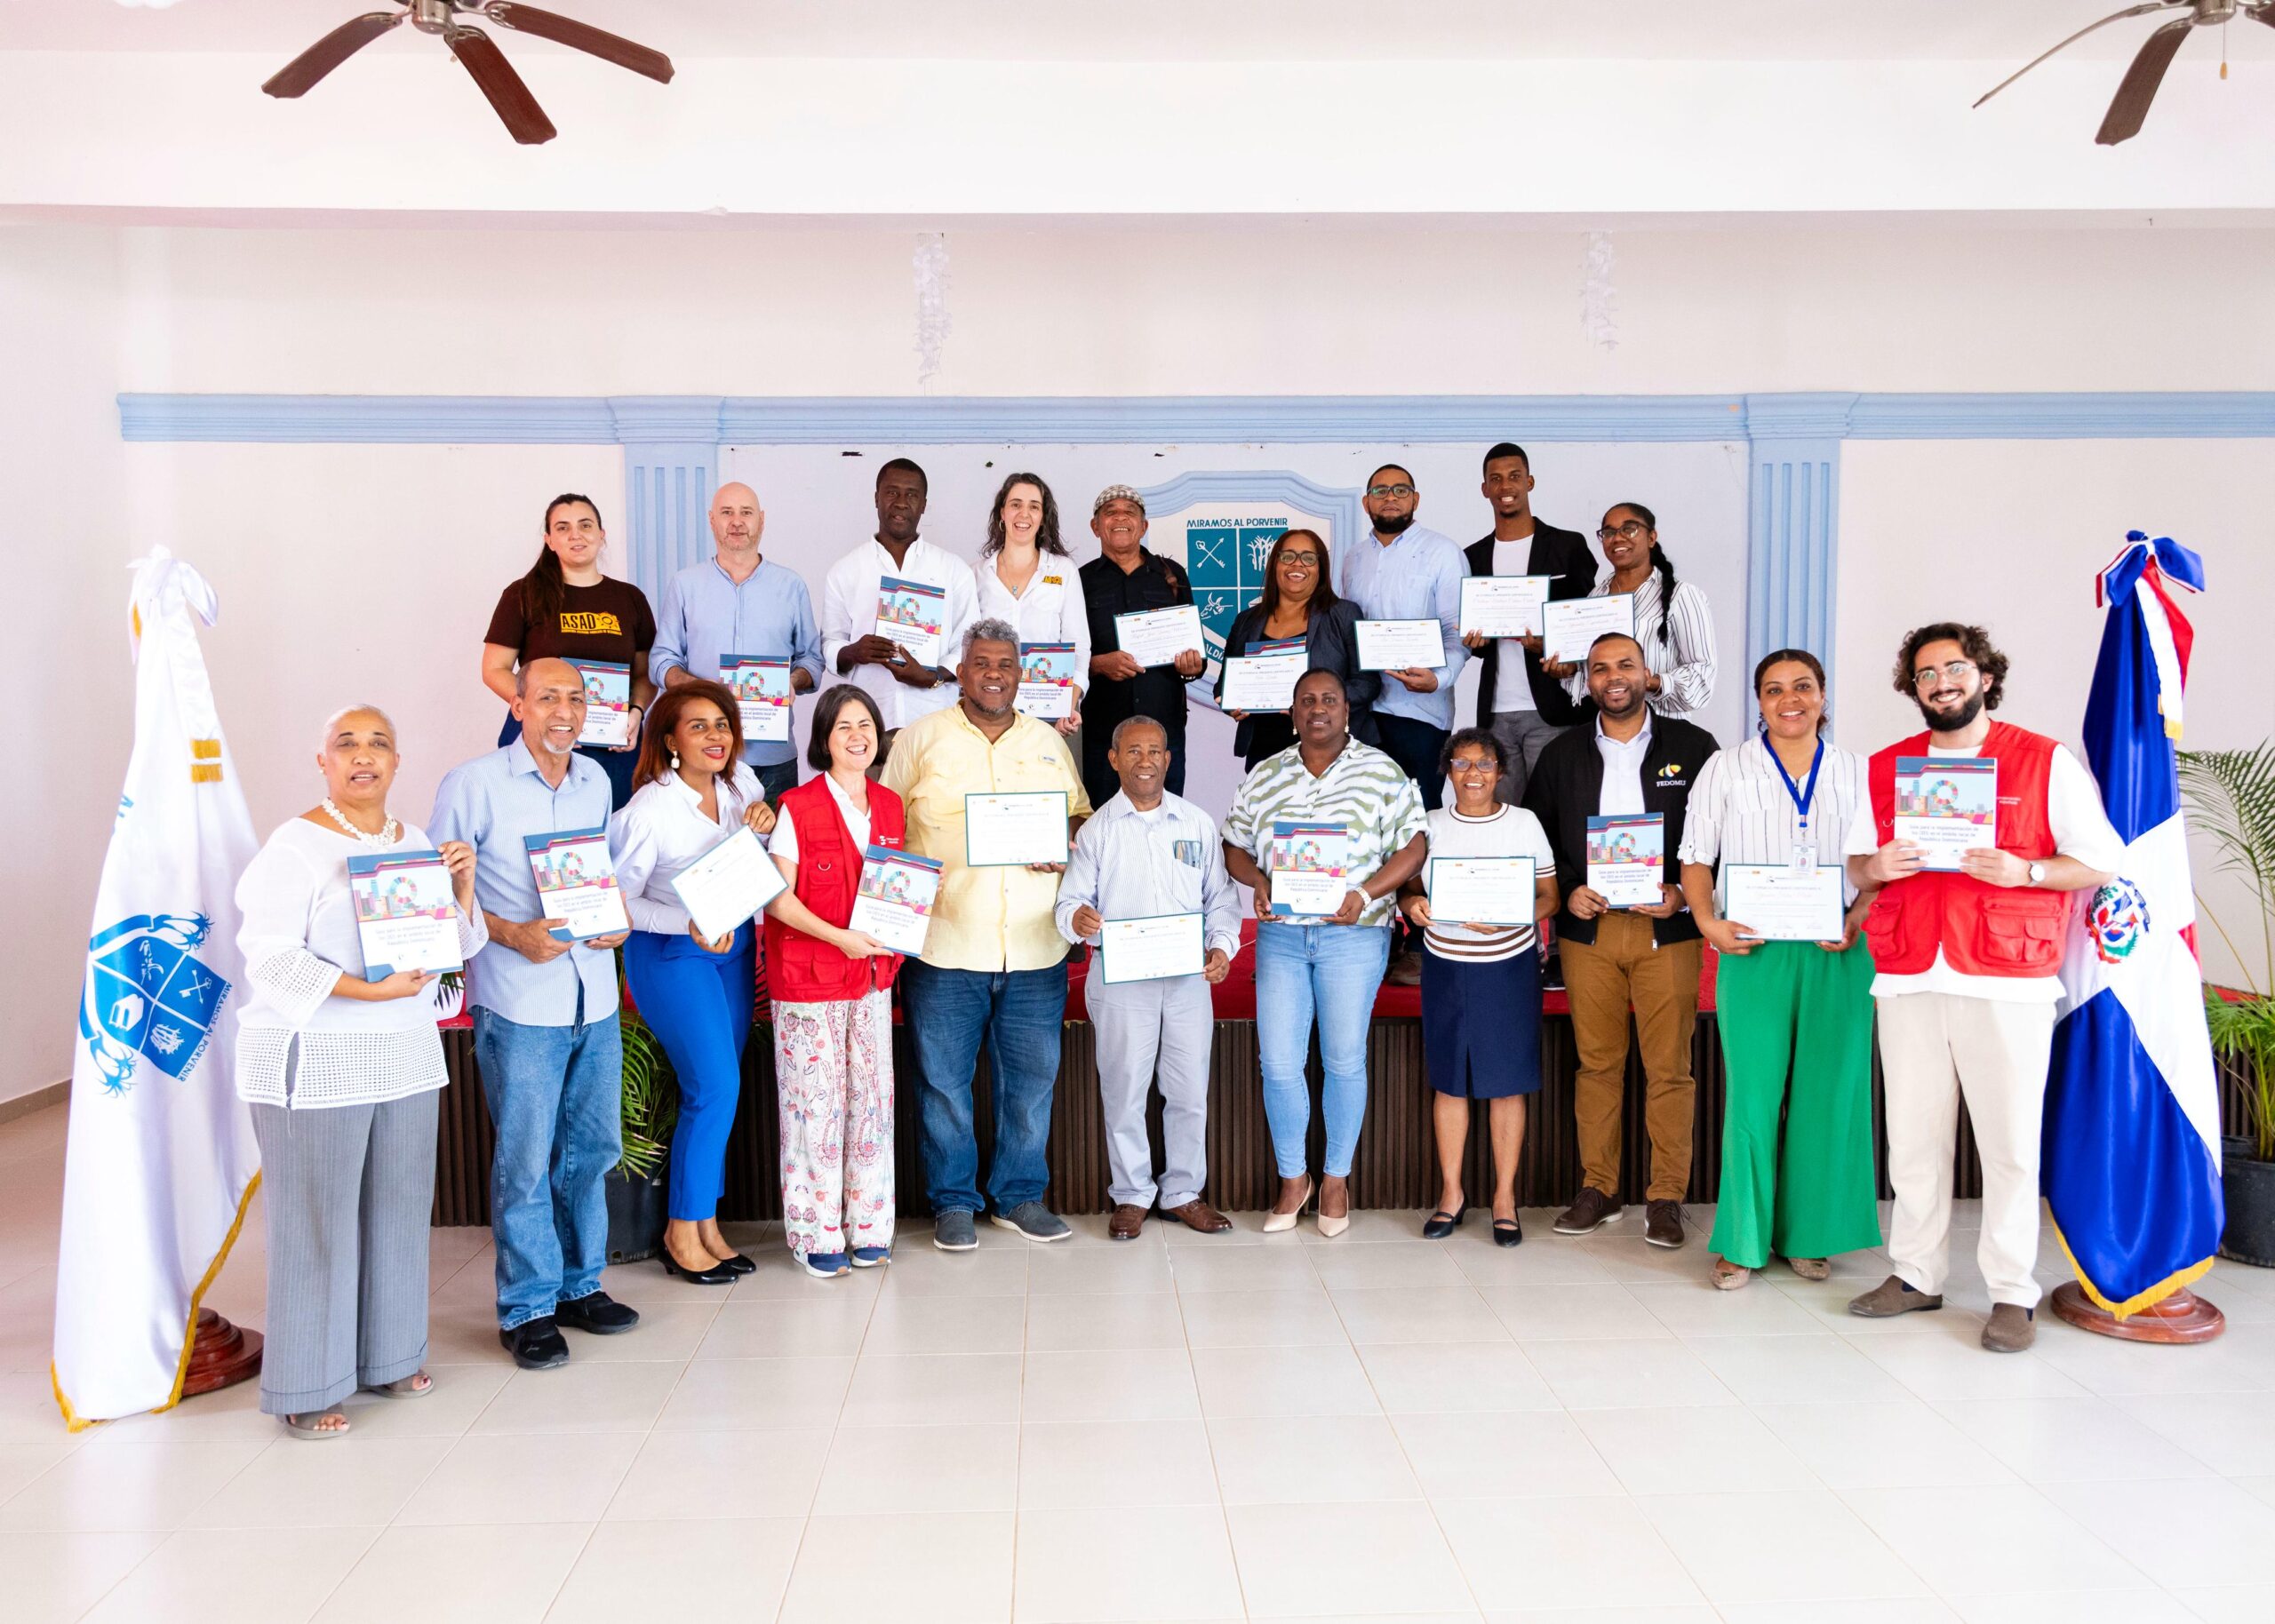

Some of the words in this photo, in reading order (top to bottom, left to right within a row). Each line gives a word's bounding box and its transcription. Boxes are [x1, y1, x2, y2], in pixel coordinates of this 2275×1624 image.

[1186, 519, 1233, 528] MIRAMOS
[1233, 518, 1244, 527] AL
[1246, 517, 1288, 527] PORVENIR
[562, 614, 596, 629] ASAD
[212, 982, 233, 1025] MIRAMOS
[205, 1027, 213, 1038] AL
[178, 1039, 209, 1082] PORVENIR
